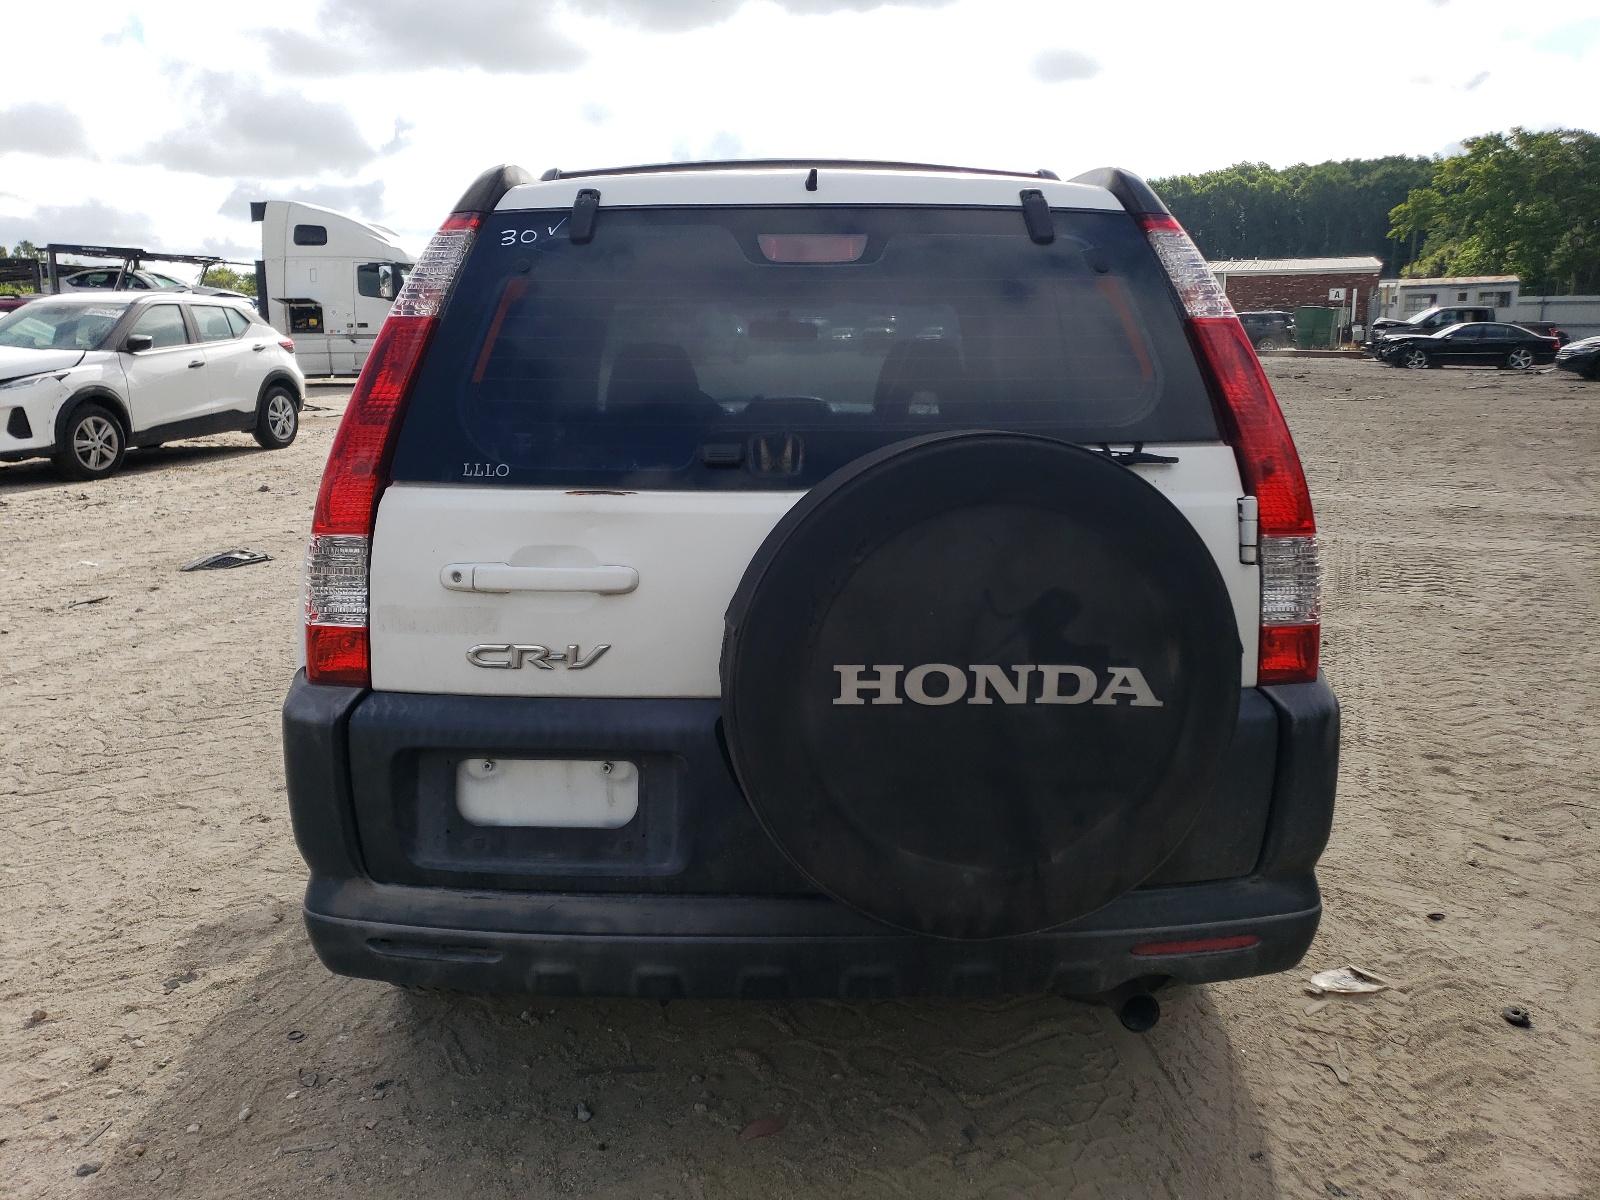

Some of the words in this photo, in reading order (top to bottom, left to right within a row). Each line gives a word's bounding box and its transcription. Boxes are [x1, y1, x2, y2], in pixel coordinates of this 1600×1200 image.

[500, 229, 537, 246] 30
[1334, 290, 1341, 299] A
[462, 462, 510, 477] LLLO
[465, 643, 612, 670] CR-V
[832, 663, 1164, 707] HONDA
